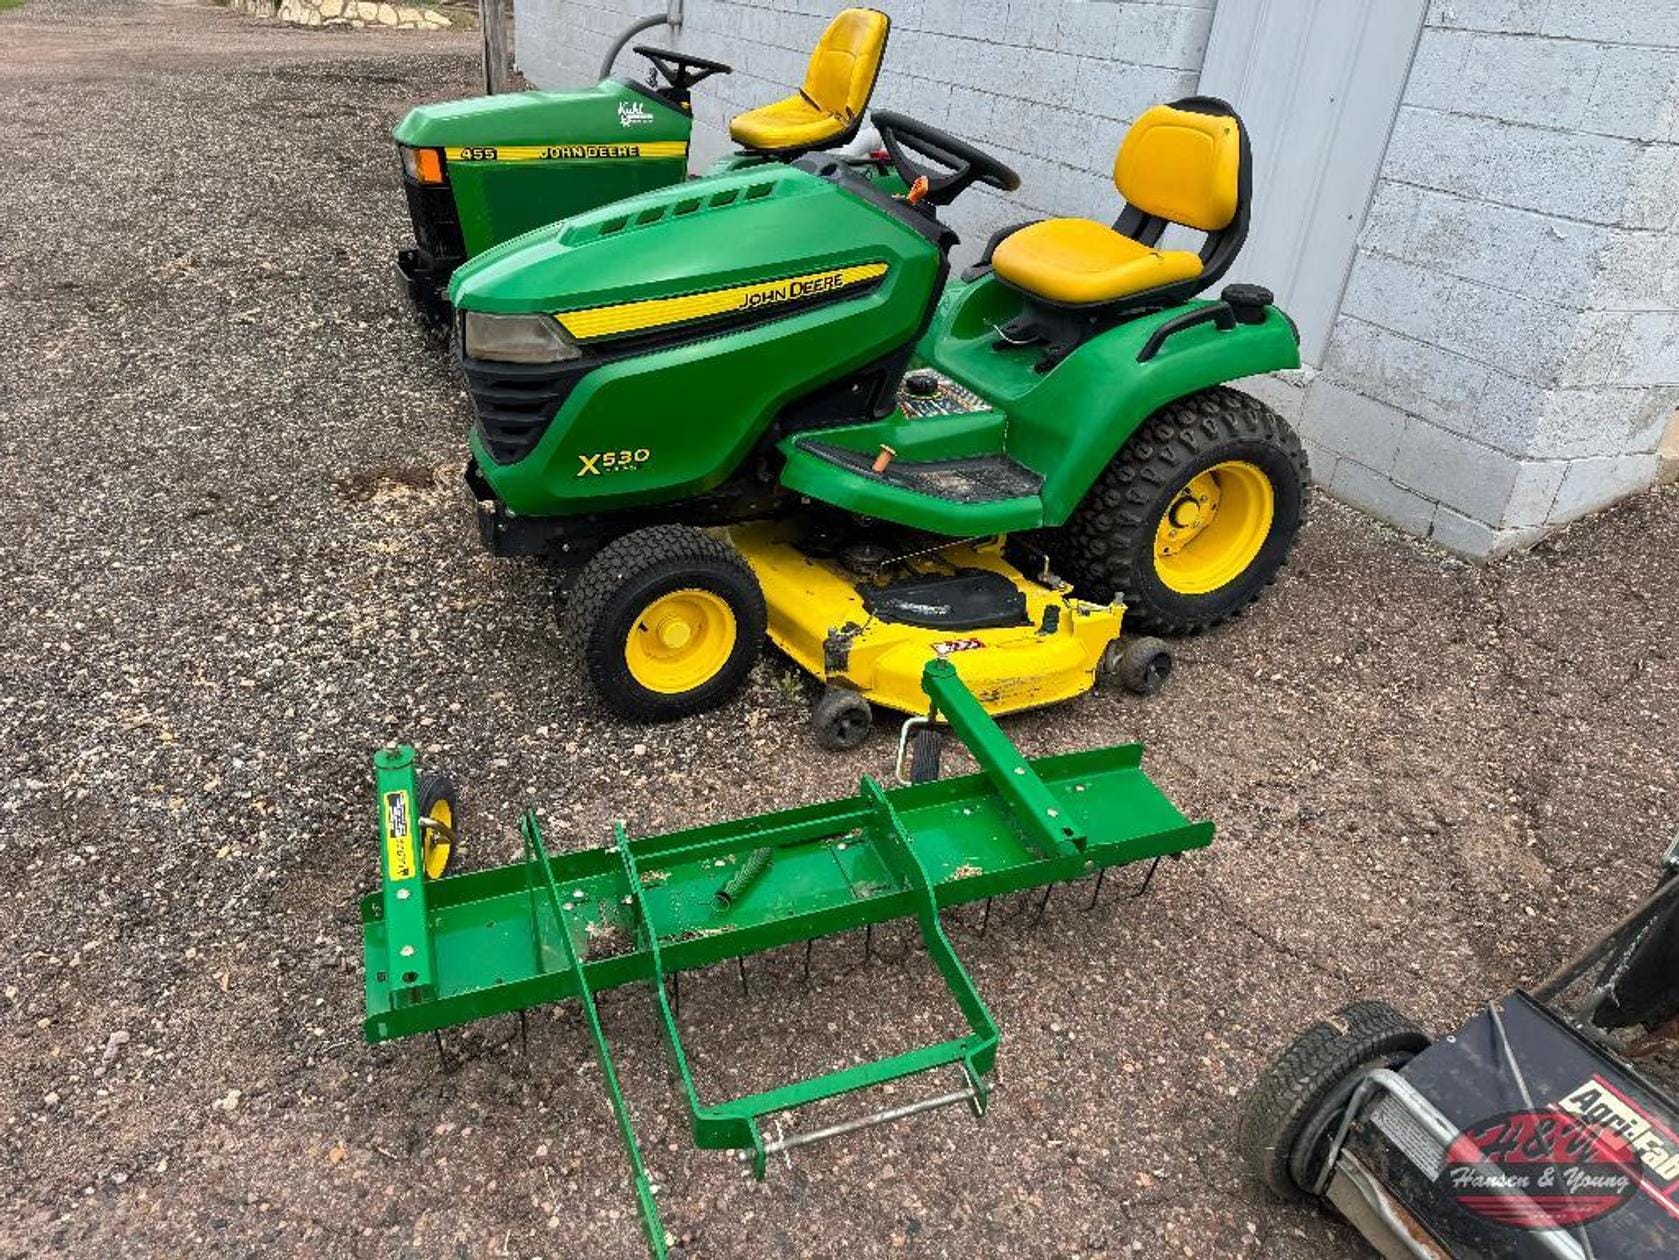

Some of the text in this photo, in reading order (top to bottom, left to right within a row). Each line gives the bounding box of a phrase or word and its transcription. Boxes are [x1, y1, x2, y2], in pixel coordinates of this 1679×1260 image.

[462, 147, 495, 160] 455
[540, 145, 639, 159] JOHN DEERE
[739, 273, 843, 310] JOHN DEERE
[576, 448, 650, 477] X530
